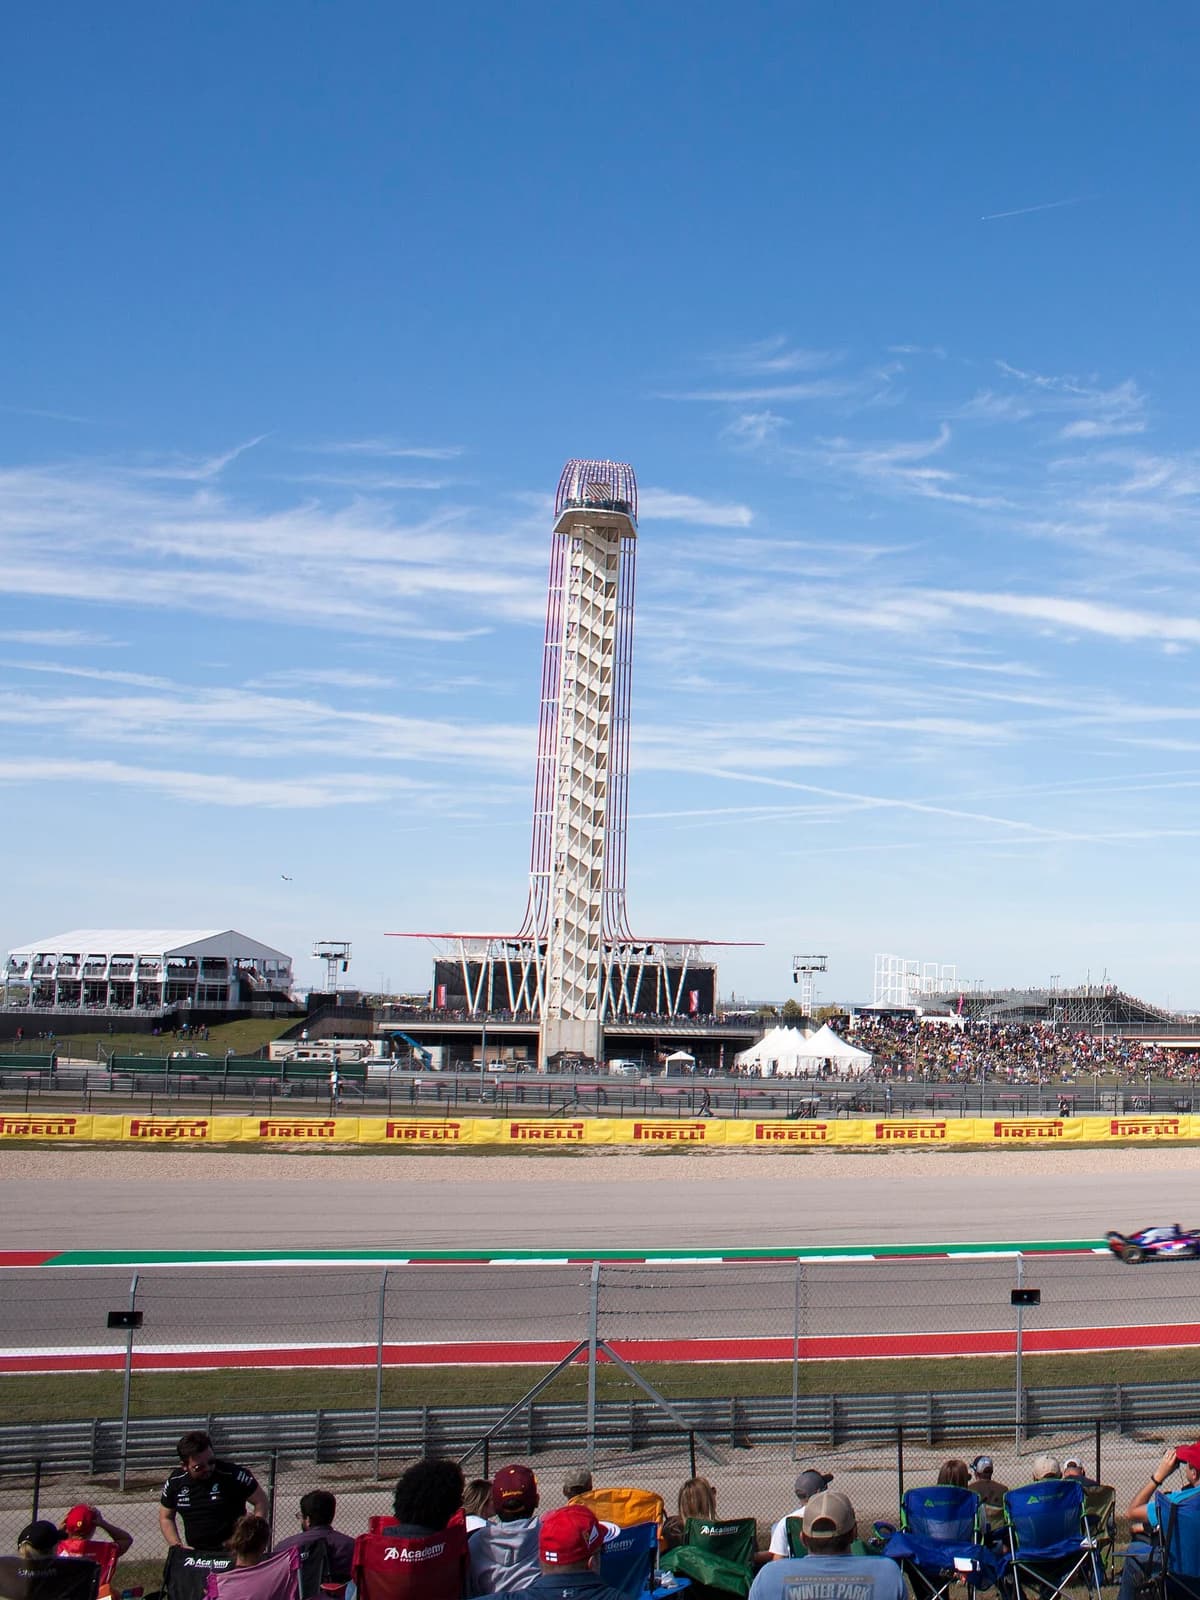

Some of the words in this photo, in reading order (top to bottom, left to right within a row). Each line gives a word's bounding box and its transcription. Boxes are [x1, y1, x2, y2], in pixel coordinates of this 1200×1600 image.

[130, 1120, 208, 1137] PIRELLI
[260, 1121, 336, 1137] PIRELLI
[386, 1122, 461, 1139] PIRELLI
[511, 1123, 585, 1139] PIRELLI
[634, 1123, 706, 1139] PIRELLI
[756, 1124, 828, 1139] PIRELLI
[876, 1123, 946, 1139] PIRELLI
[994, 1122, 1064, 1137] PIRELLI
[1111, 1120, 1180, 1136] PIRELLI
[400, 1542, 447, 1559] Academy
[788, 1584, 836, 1600] WINTER
[836, 1584, 873, 1600] PARK
